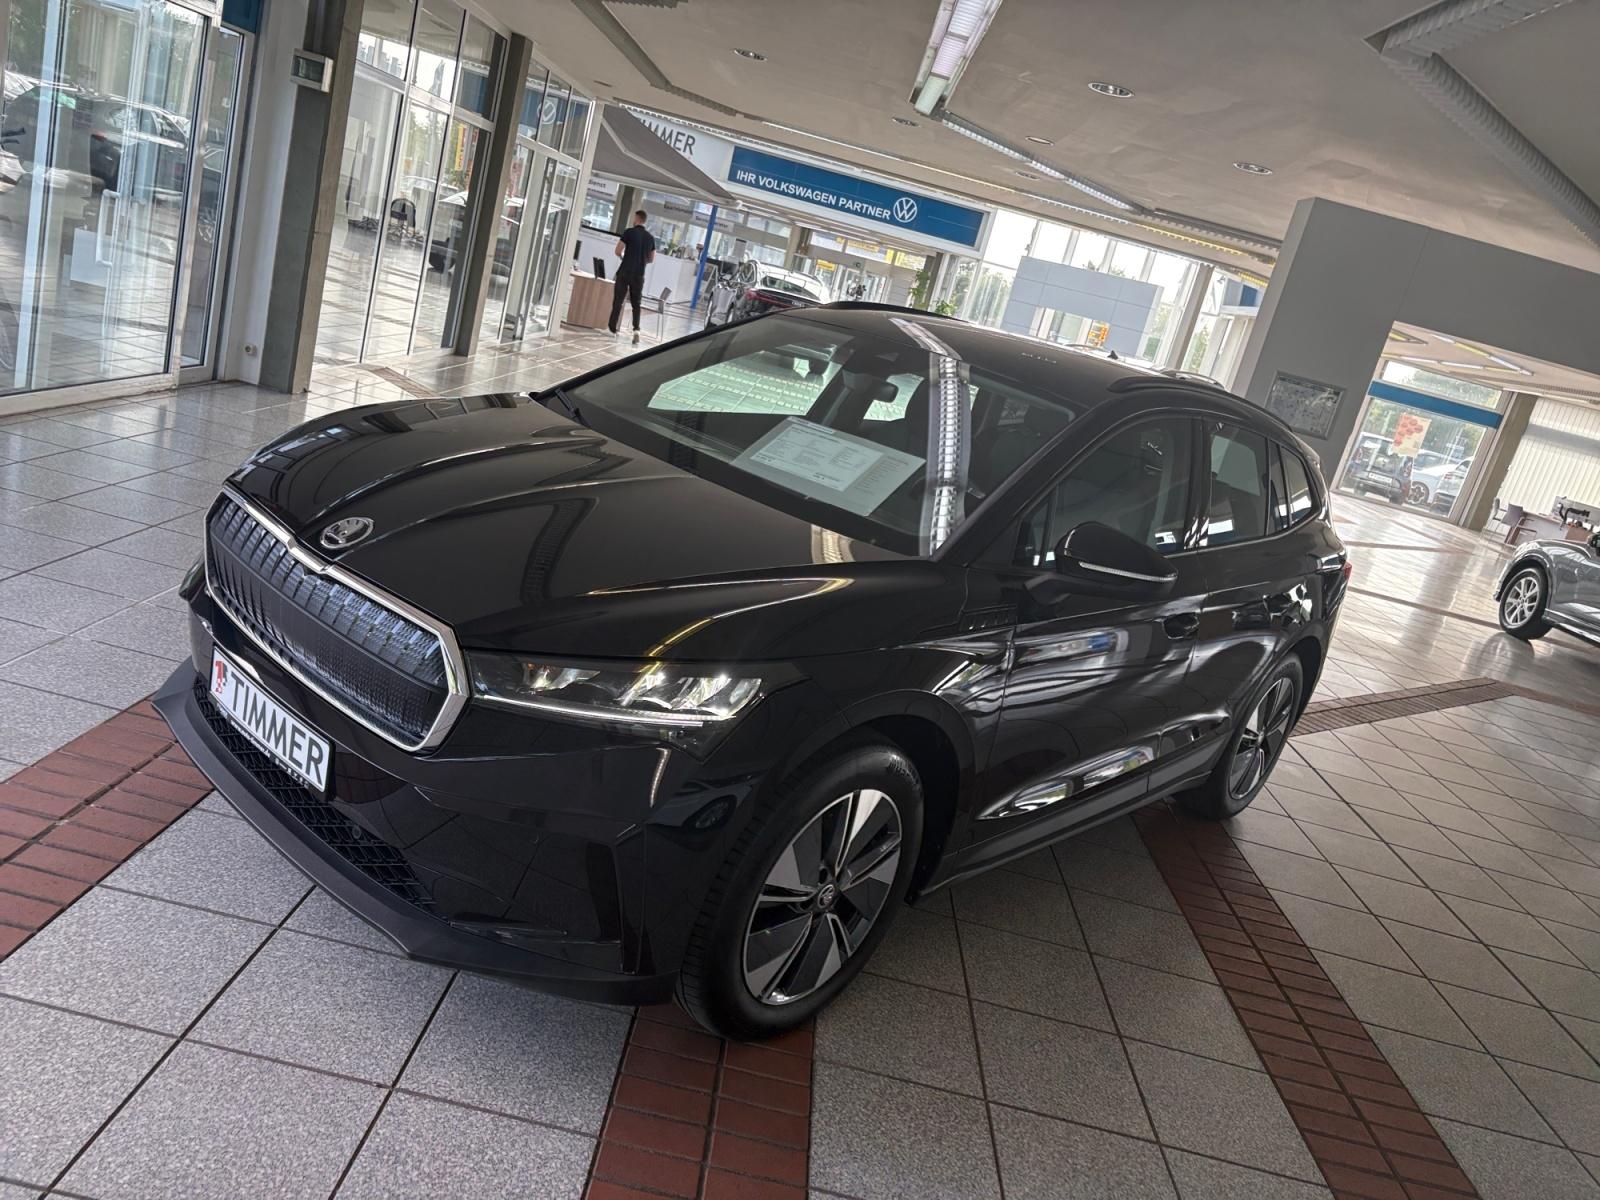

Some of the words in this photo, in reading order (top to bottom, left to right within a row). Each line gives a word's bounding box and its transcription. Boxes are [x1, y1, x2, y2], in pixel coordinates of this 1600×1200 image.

[736, 169, 756, 185] IHR
[758, 176, 838, 206] VOLKSWAGEN
[838, 197, 892, 220] PARTNER
[230, 670, 324, 786] TIMMER
